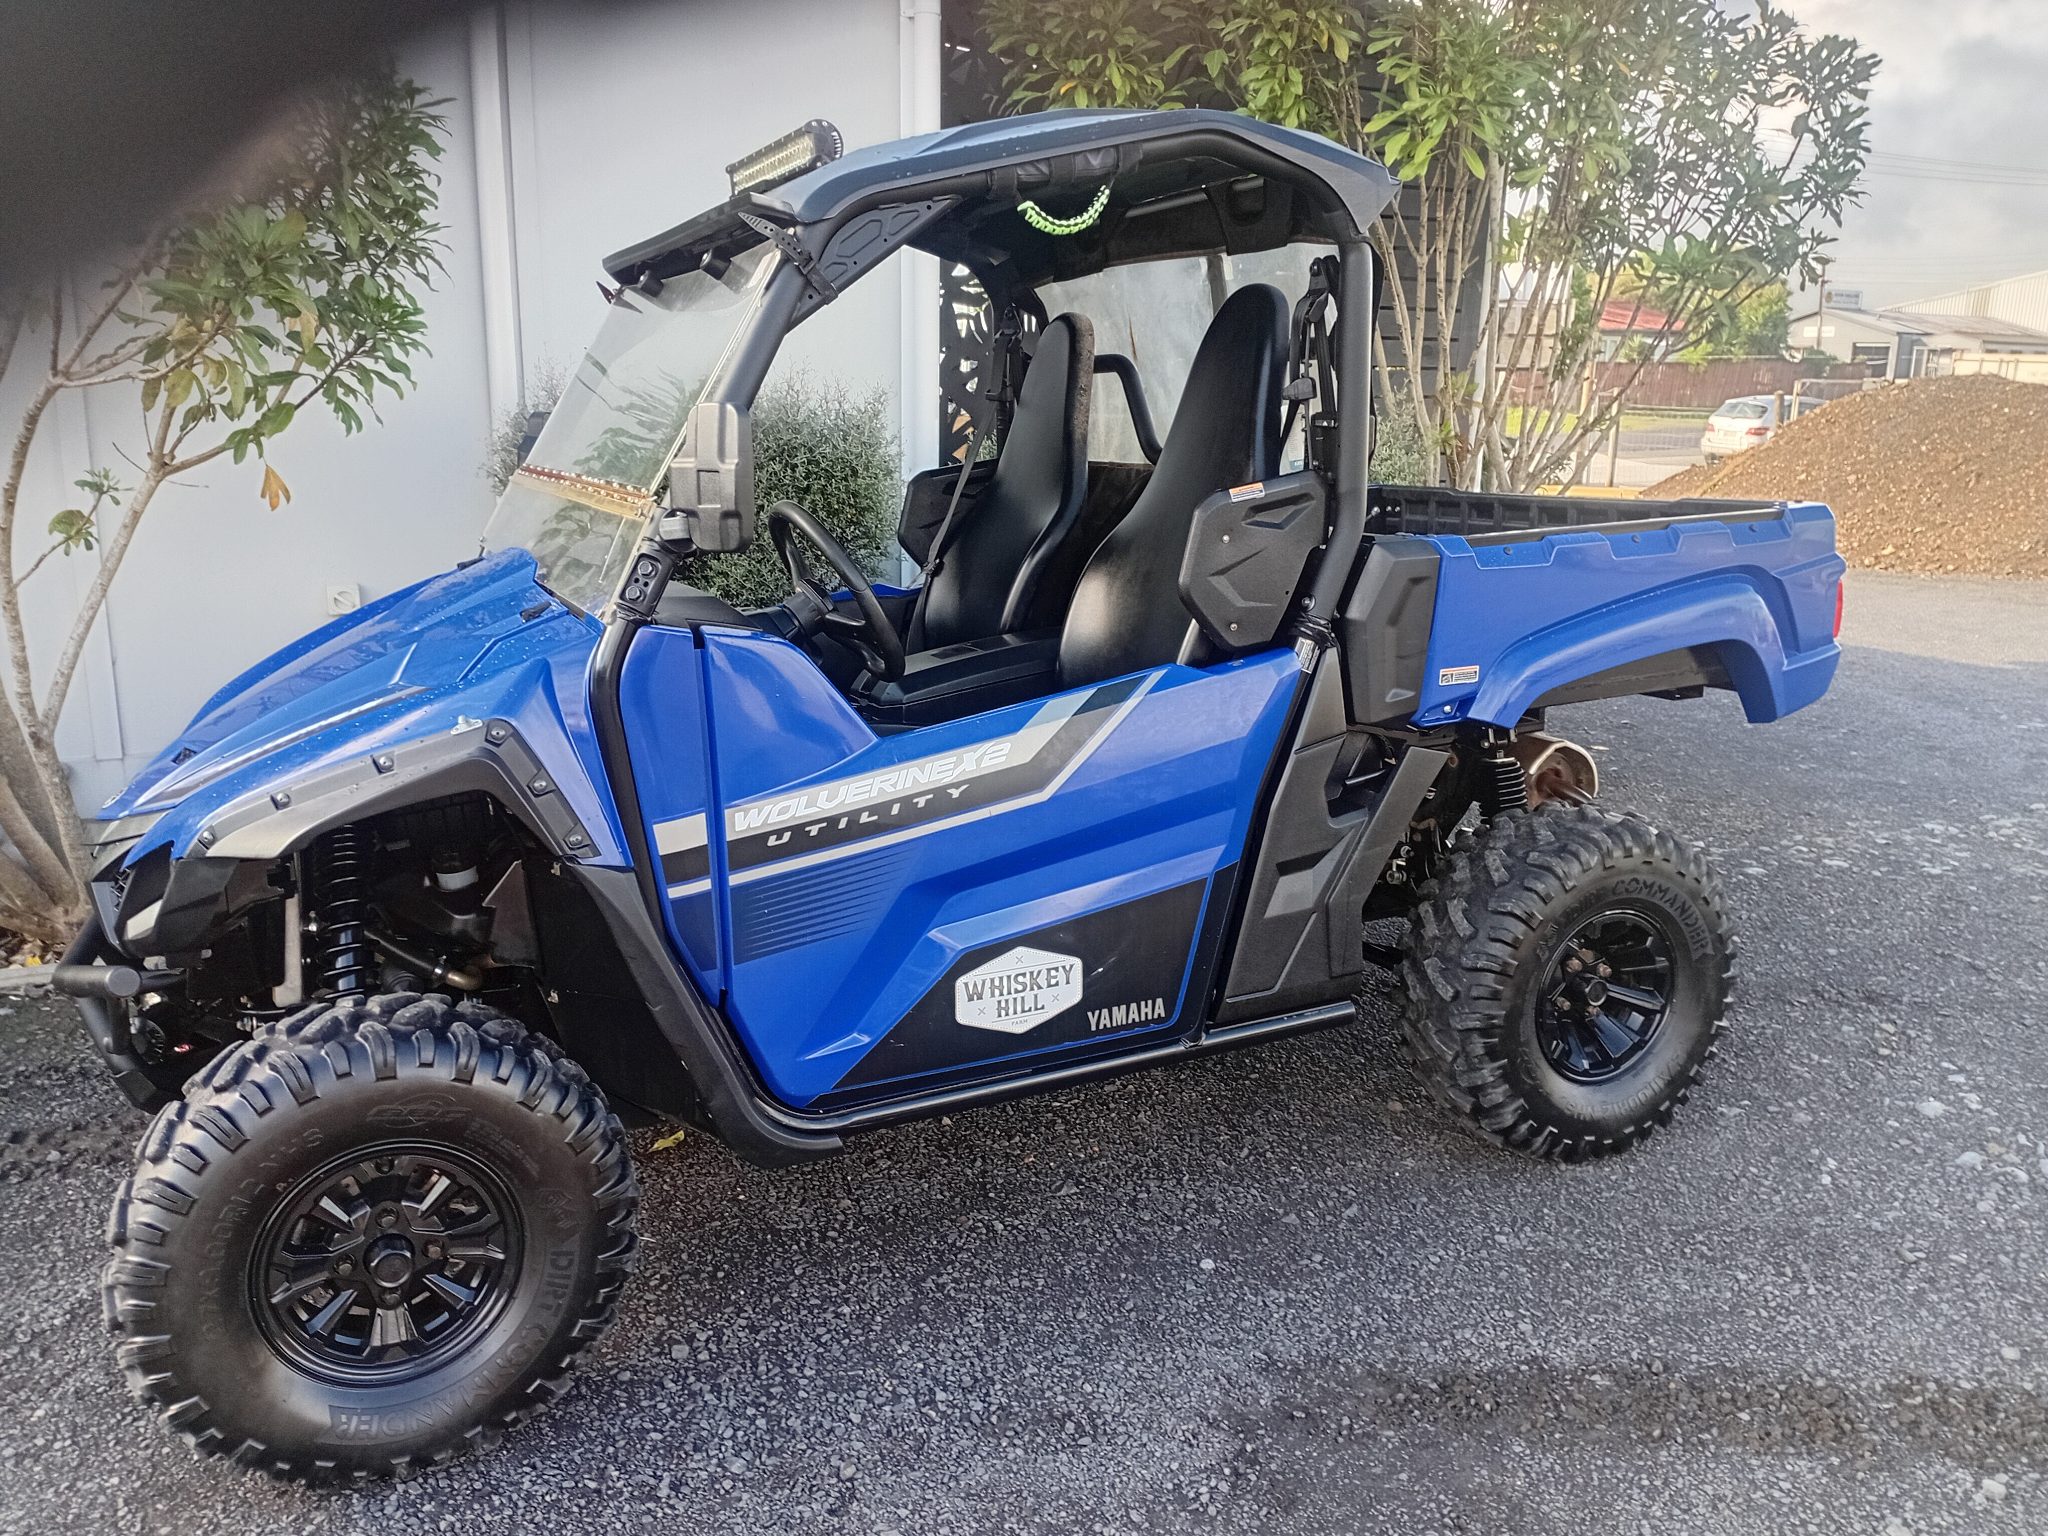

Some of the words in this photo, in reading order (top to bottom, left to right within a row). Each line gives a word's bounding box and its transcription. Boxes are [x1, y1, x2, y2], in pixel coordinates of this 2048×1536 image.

[766, 784, 970, 847] UTILITY
[1611, 877, 1710, 953] COMMANDER
[963, 963, 1075, 1003] WHISKEY
[996, 993, 1046, 1018] HILL
[1087, 997, 1166, 1032] YAMAHA
[542, 1252, 575, 1315] DIRT
[332, 1321, 549, 1442] COMMANDER
